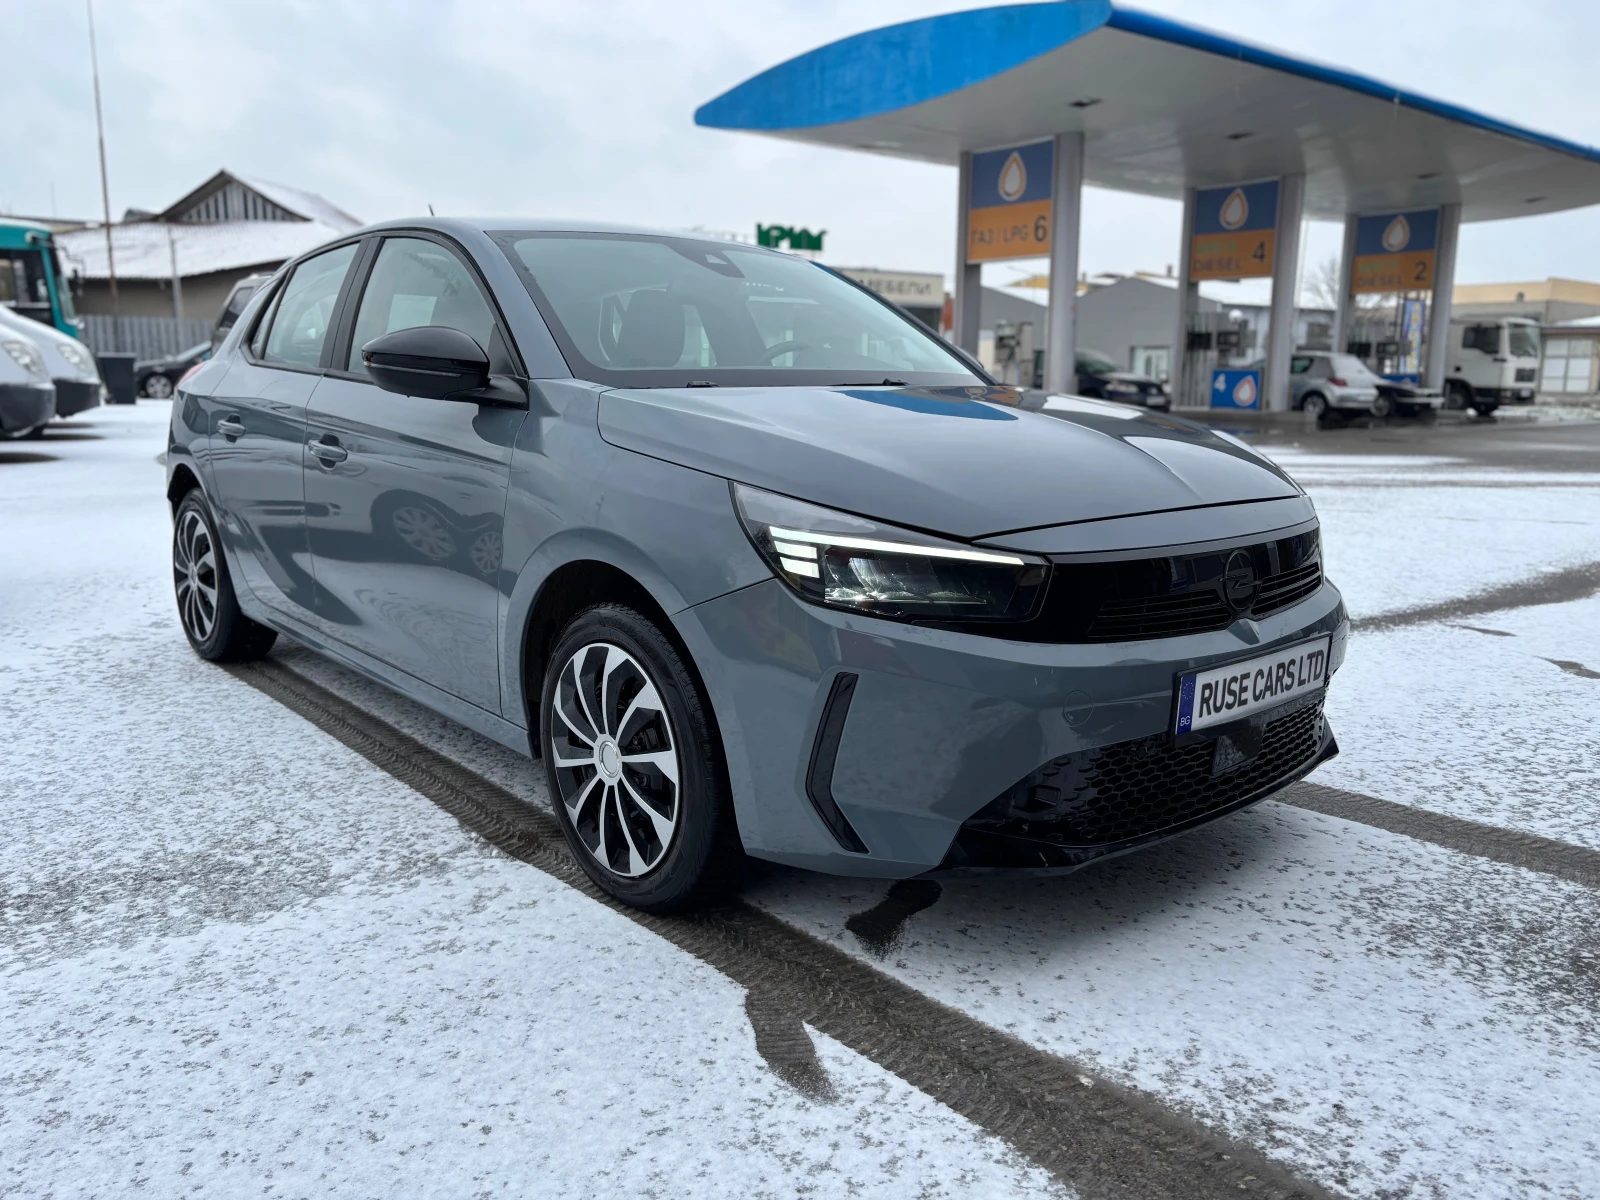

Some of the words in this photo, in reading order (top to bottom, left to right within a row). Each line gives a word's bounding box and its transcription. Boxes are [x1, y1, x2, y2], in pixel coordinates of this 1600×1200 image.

[1003, 224, 1029, 243] LPG
[1034, 214, 1047, 243] 6
[1252, 241, 1266, 263] 4
[1414, 260, 1427, 282] 2
[1213, 373, 1227, 393] 4
[1199, 672, 1250, 718] RUSE
[1252, 658, 1296, 703] CARS
[1298, 649, 1325, 687] LTD
[1179, 715, 1191, 727] BG
